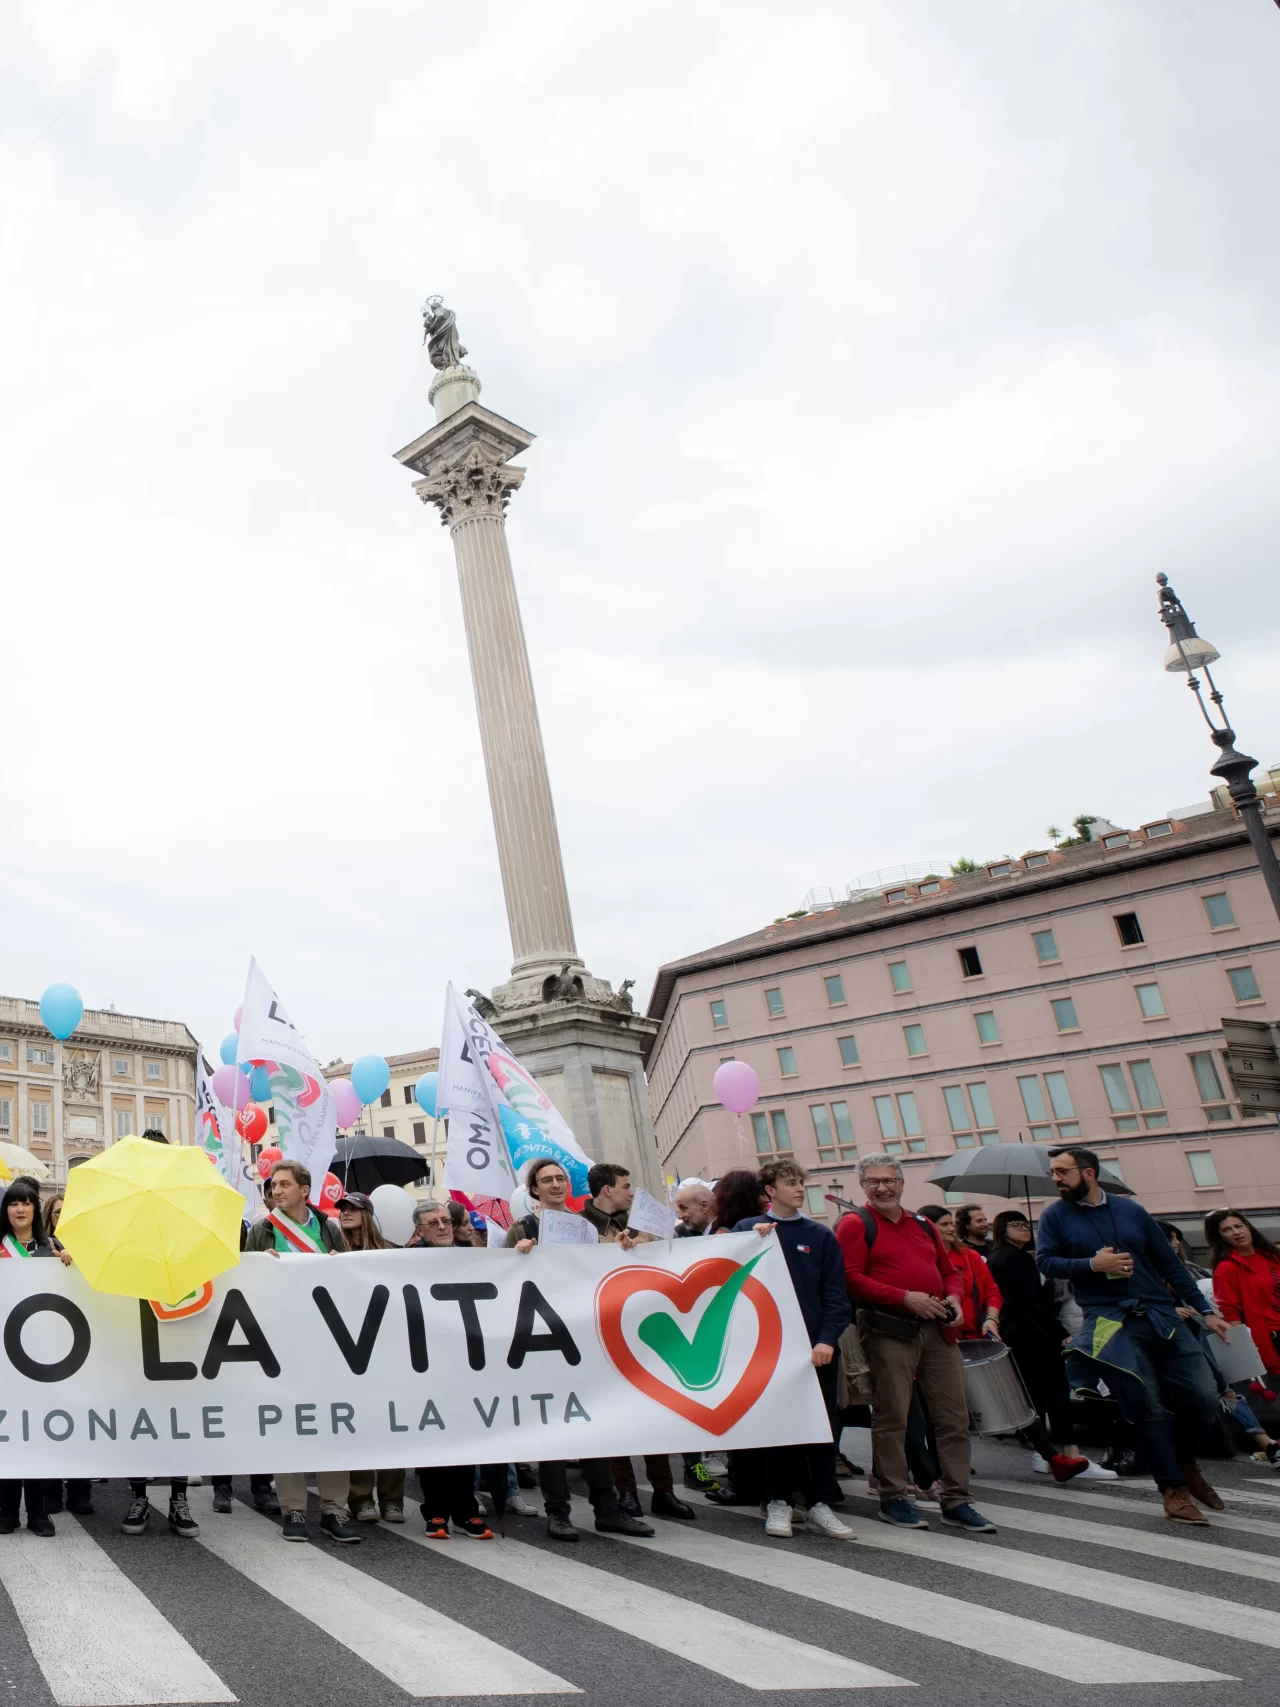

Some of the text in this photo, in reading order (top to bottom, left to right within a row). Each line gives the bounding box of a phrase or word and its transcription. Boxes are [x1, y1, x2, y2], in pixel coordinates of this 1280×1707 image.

[138, 1287, 281, 1381] LA
[311, 1280, 581, 1376] VITA
[257, 1402, 356, 1437] PER
[388, 1398, 446, 1433] LA
[472, 1391, 592, 1429] VITA
